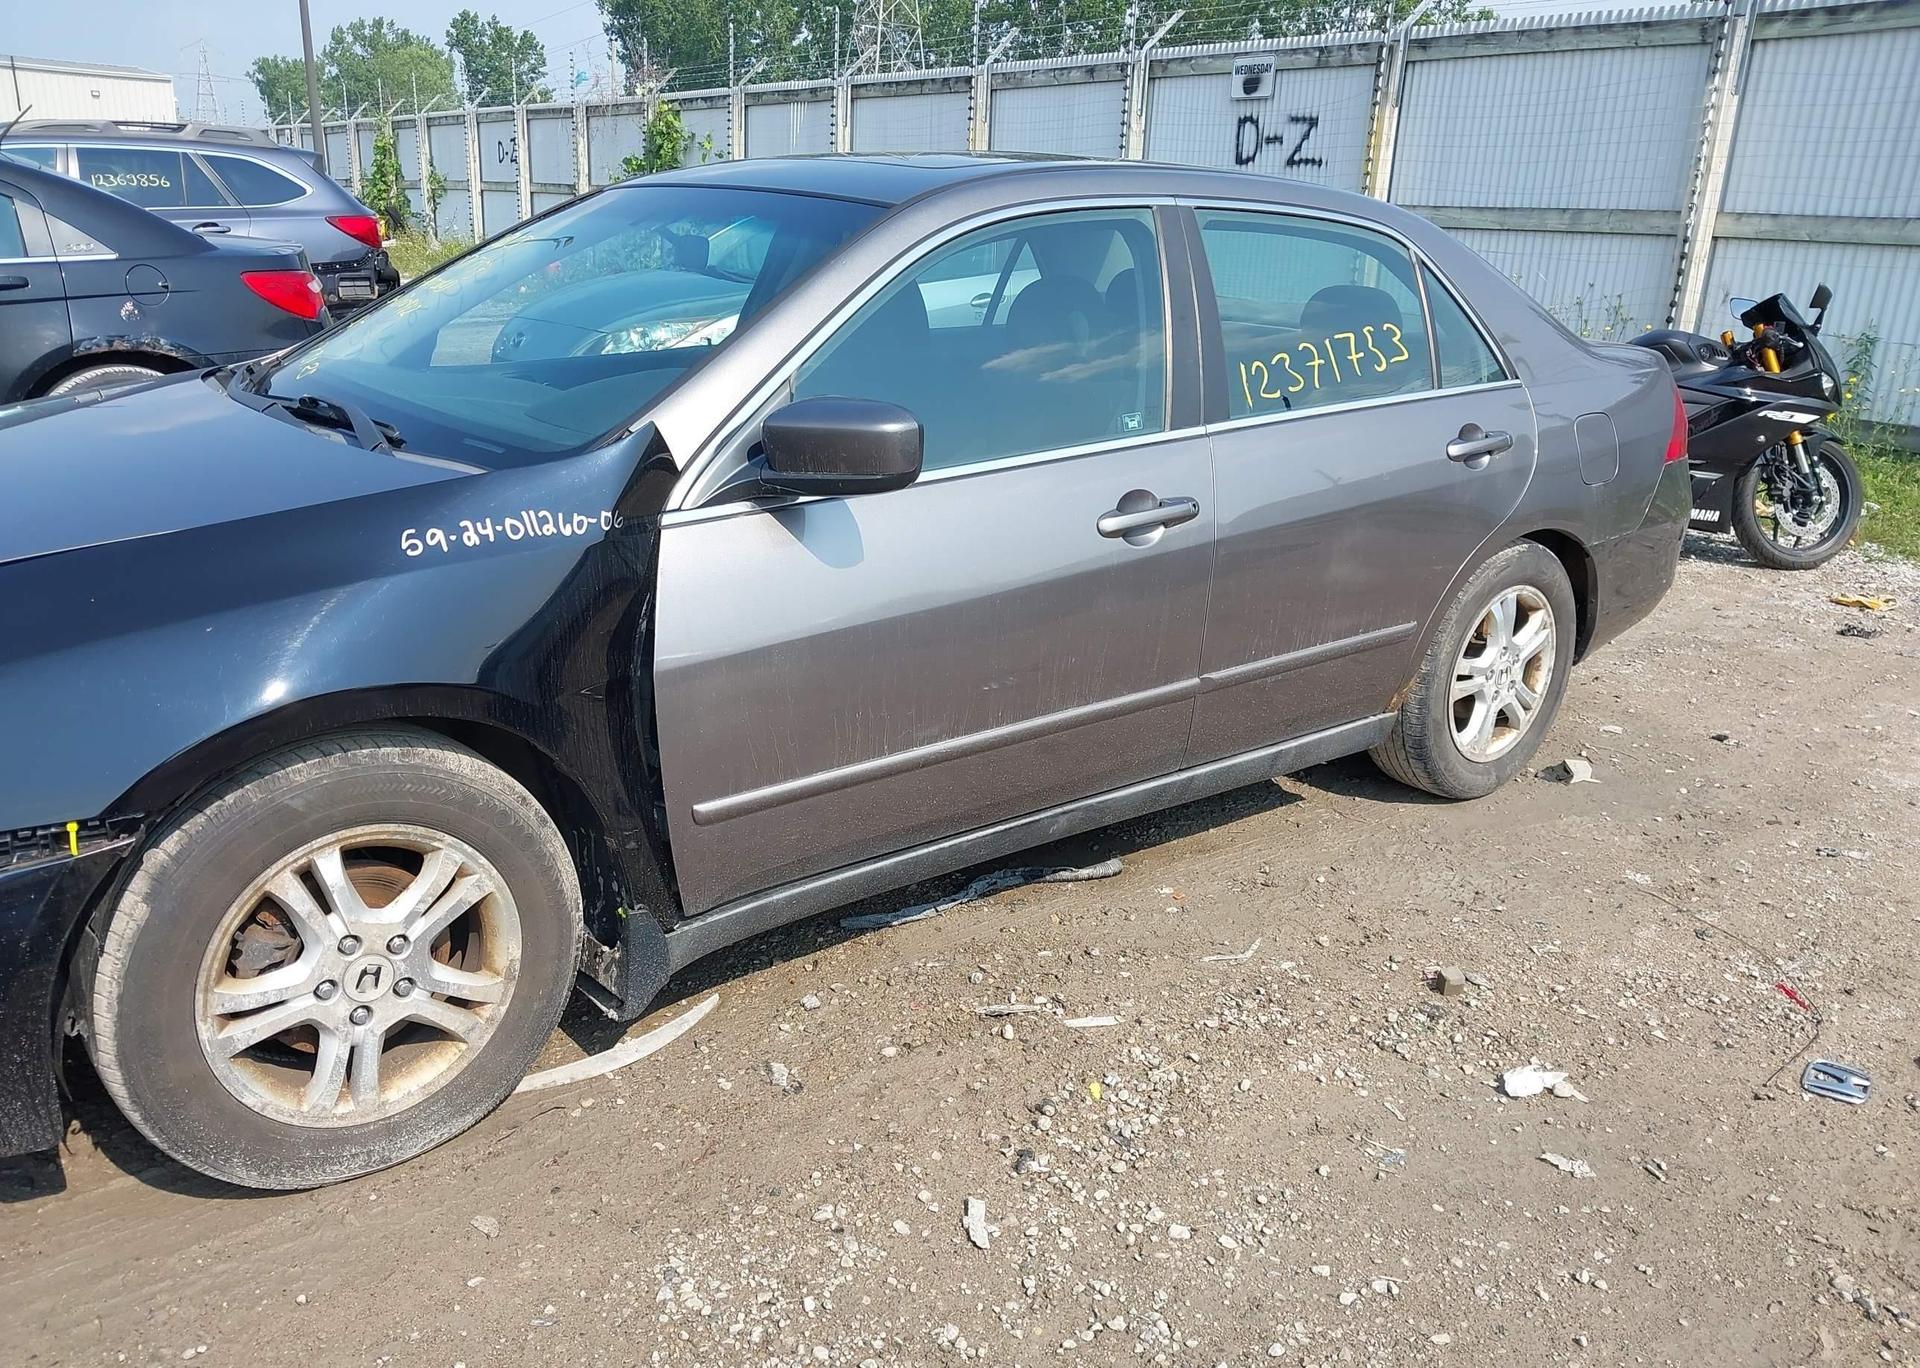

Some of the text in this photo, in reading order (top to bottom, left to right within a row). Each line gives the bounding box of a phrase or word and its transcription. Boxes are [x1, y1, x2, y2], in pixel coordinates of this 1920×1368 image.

[1234, 62, 1274, 76] WEDNESDAY
[1236, 112, 1323, 168] D-Z
[91, 173, 171, 187] 12369856
[1239, 322, 1409, 410] 12371753
[1690, 508, 1720, 522] MAHA
